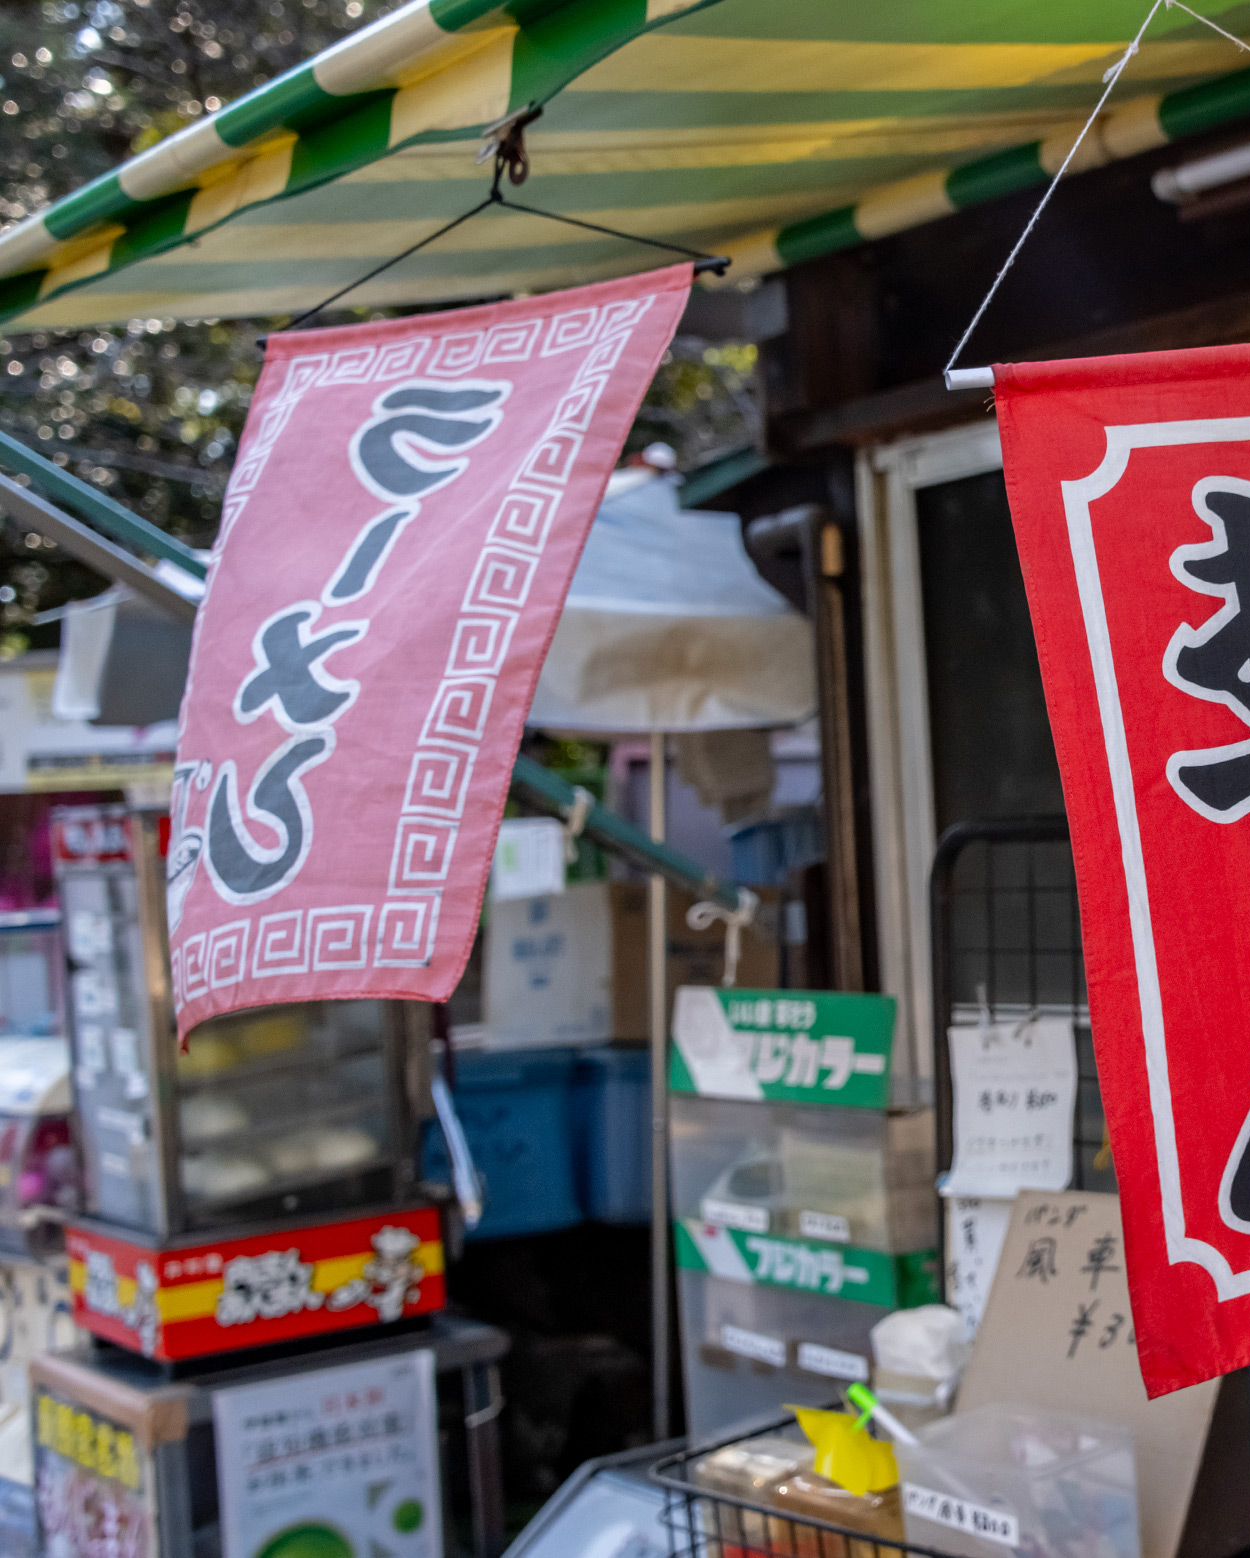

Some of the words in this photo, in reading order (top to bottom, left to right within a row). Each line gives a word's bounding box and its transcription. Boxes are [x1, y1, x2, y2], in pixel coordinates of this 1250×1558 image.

[203, 379, 513, 905] ラーメン
[745, 1234, 870, 1294] フジカラー
